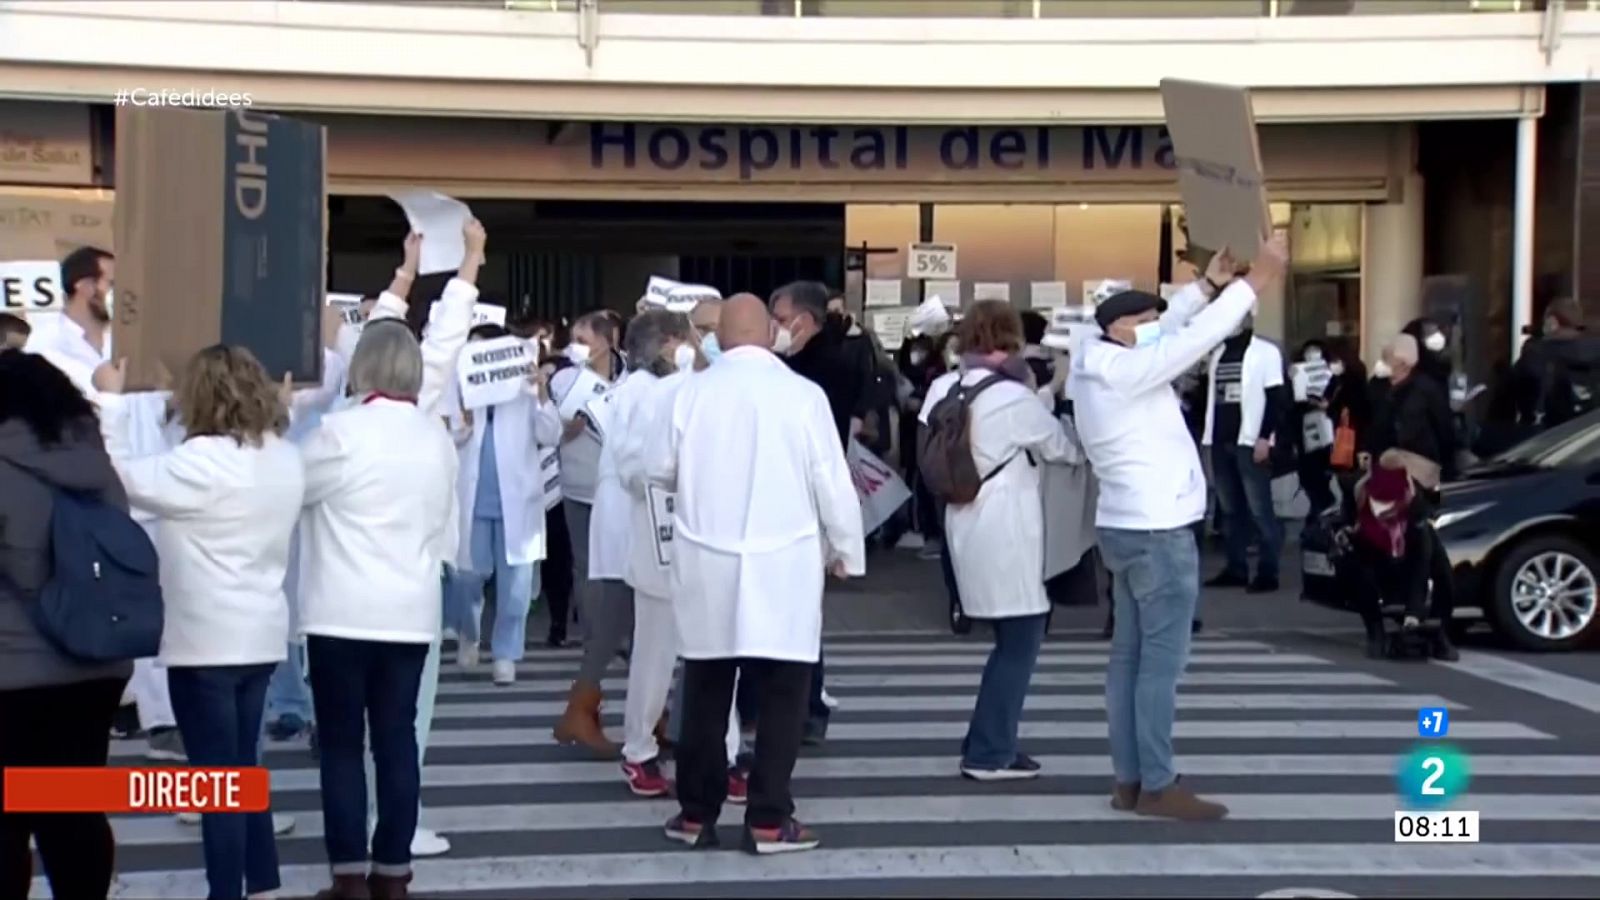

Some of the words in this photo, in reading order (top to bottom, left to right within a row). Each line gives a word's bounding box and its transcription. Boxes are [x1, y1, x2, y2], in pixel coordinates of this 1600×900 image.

[590, 122, 907, 180] Hospital
[940, 124, 1050, 171] del
[1082, 124, 1178, 170] Ma
[916, 253, 948, 273] 5%
